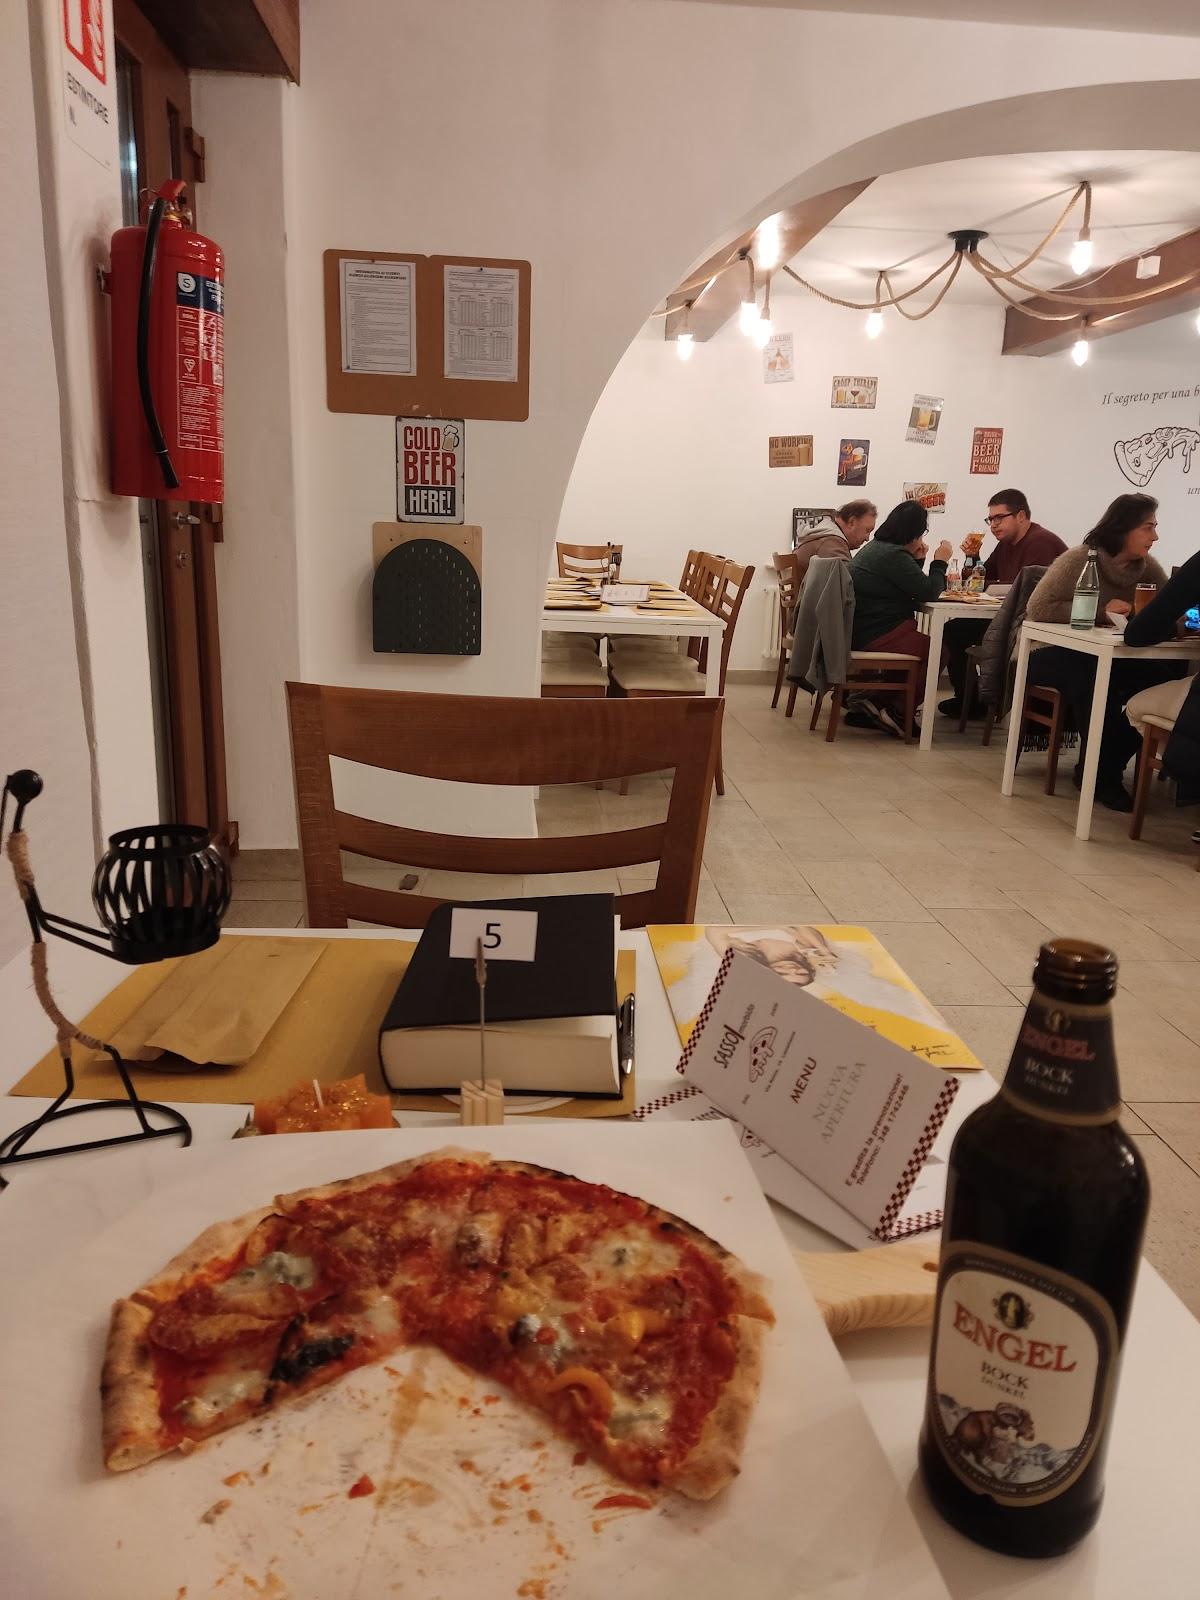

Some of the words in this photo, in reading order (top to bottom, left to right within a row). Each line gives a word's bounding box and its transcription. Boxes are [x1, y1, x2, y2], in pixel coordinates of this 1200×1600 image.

[1102, 391, 1114, 405] Il
[1114, 392, 1149, 407] segreto
[1151, 390, 1169, 404] per
[1171, 389, 1190, 399] una
[403, 425, 441, 451] COLD
[769, 438, 779, 448] NO
[973, 444, 1000, 457] BEER
[403, 450, 456, 486] BEER
[408, 488, 452, 514] HERE!
[483, 923, 502, 949] 5
[1021, 1023, 1097, 1062] ENGEL
[790, 1057, 818, 1105] MENU
[812, 1064, 849, 1122] NUOVA
[820, 1061, 867, 1145] APERTURA
[952, 1299, 1078, 1374] ENGEL
[980, 1360, 1030, 1390] BOCK
